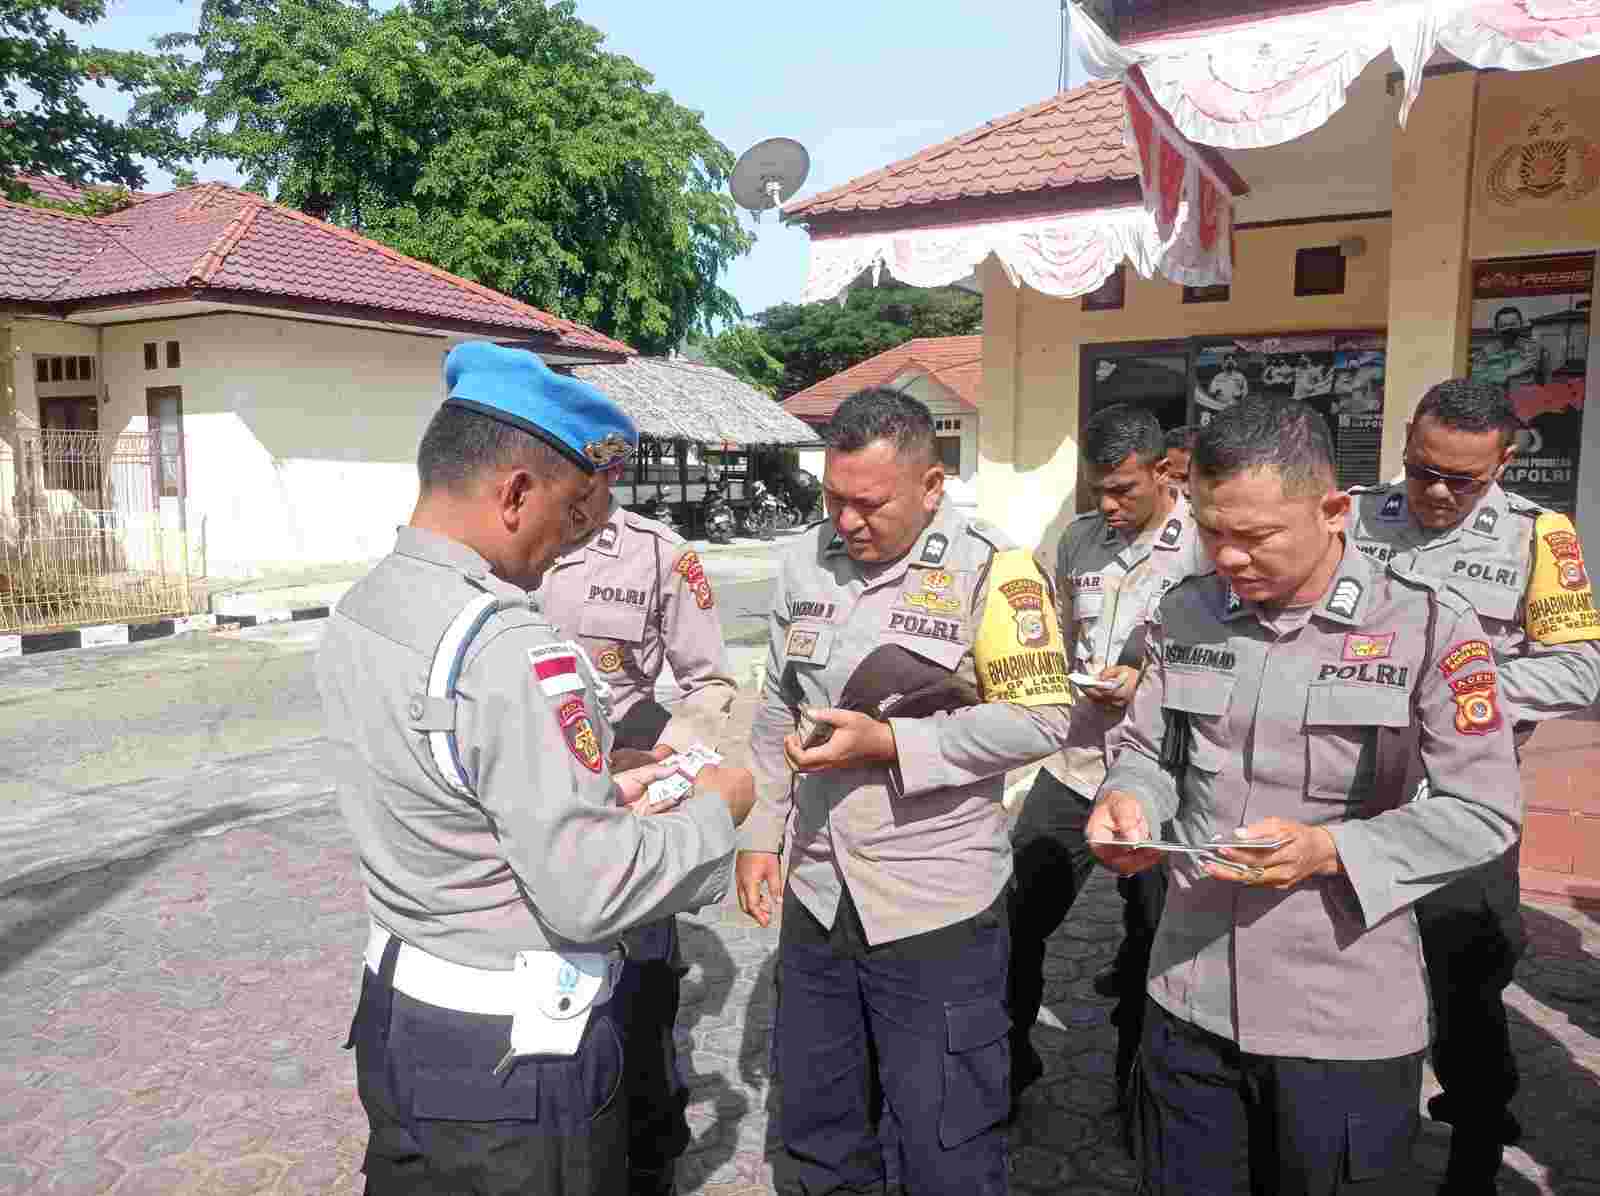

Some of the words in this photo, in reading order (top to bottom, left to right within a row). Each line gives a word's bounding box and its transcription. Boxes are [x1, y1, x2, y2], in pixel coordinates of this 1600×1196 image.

[1504, 468, 1572, 482] APOLRI
[1453, 560, 1517, 586] POLRI
[589, 584, 647, 605] POLRI
[888, 612, 960, 640] POLRI
[1318, 663, 1408, 688] POLRI
